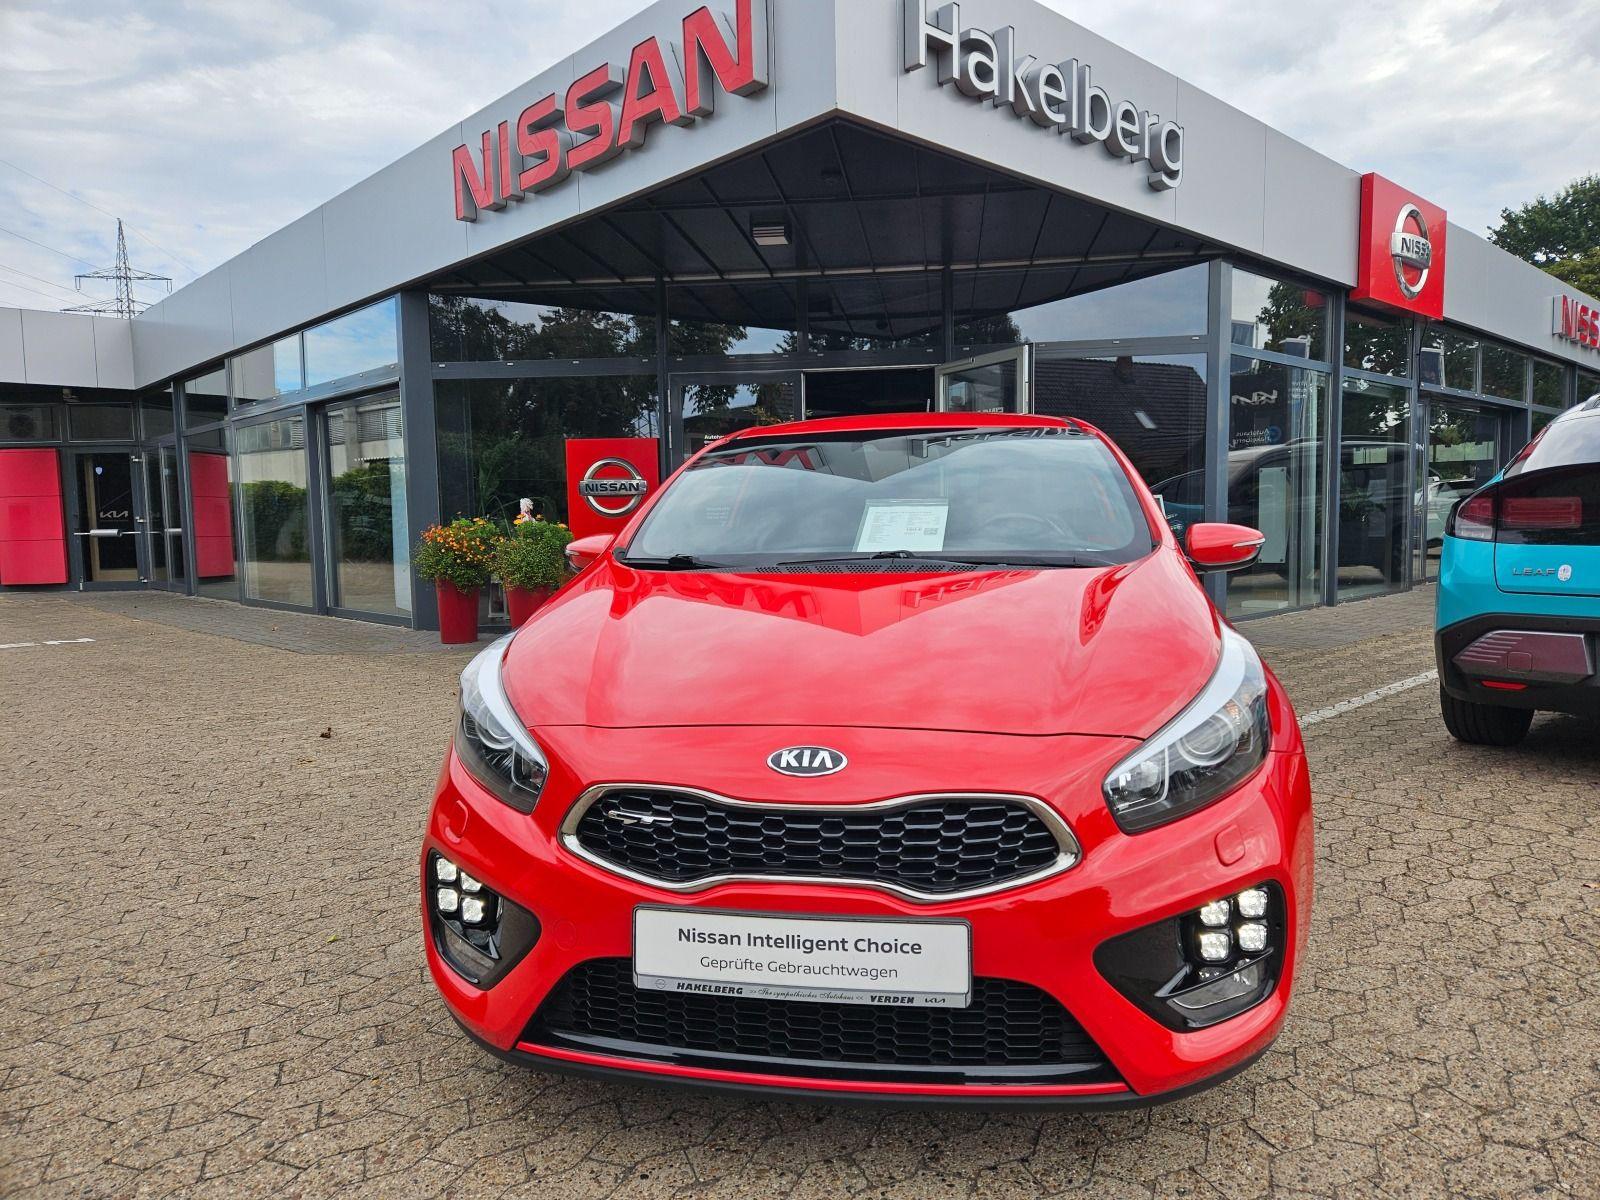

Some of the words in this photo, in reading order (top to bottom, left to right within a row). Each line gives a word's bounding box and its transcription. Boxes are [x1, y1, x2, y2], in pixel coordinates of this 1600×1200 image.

[904, 0, 1185, 190] Hakelberg
[452, 0, 764, 222] NISSAN
[584, 481, 641, 493] NISSAN
[1512, 567, 1556, 576] LEAF
[779, 749, 834, 769] KIA
[678, 927, 742, 946] Nissan
[747, 932, 849, 954] Intelligent
[854, 938, 922, 955] Choice
[700, 956, 764, 972] Geprüfte
[767, 960, 898, 981] Gebrauchtwagen
[676, 982, 743, 995] HAKELBERG
[870, 994, 915, 1004] VERDEN
